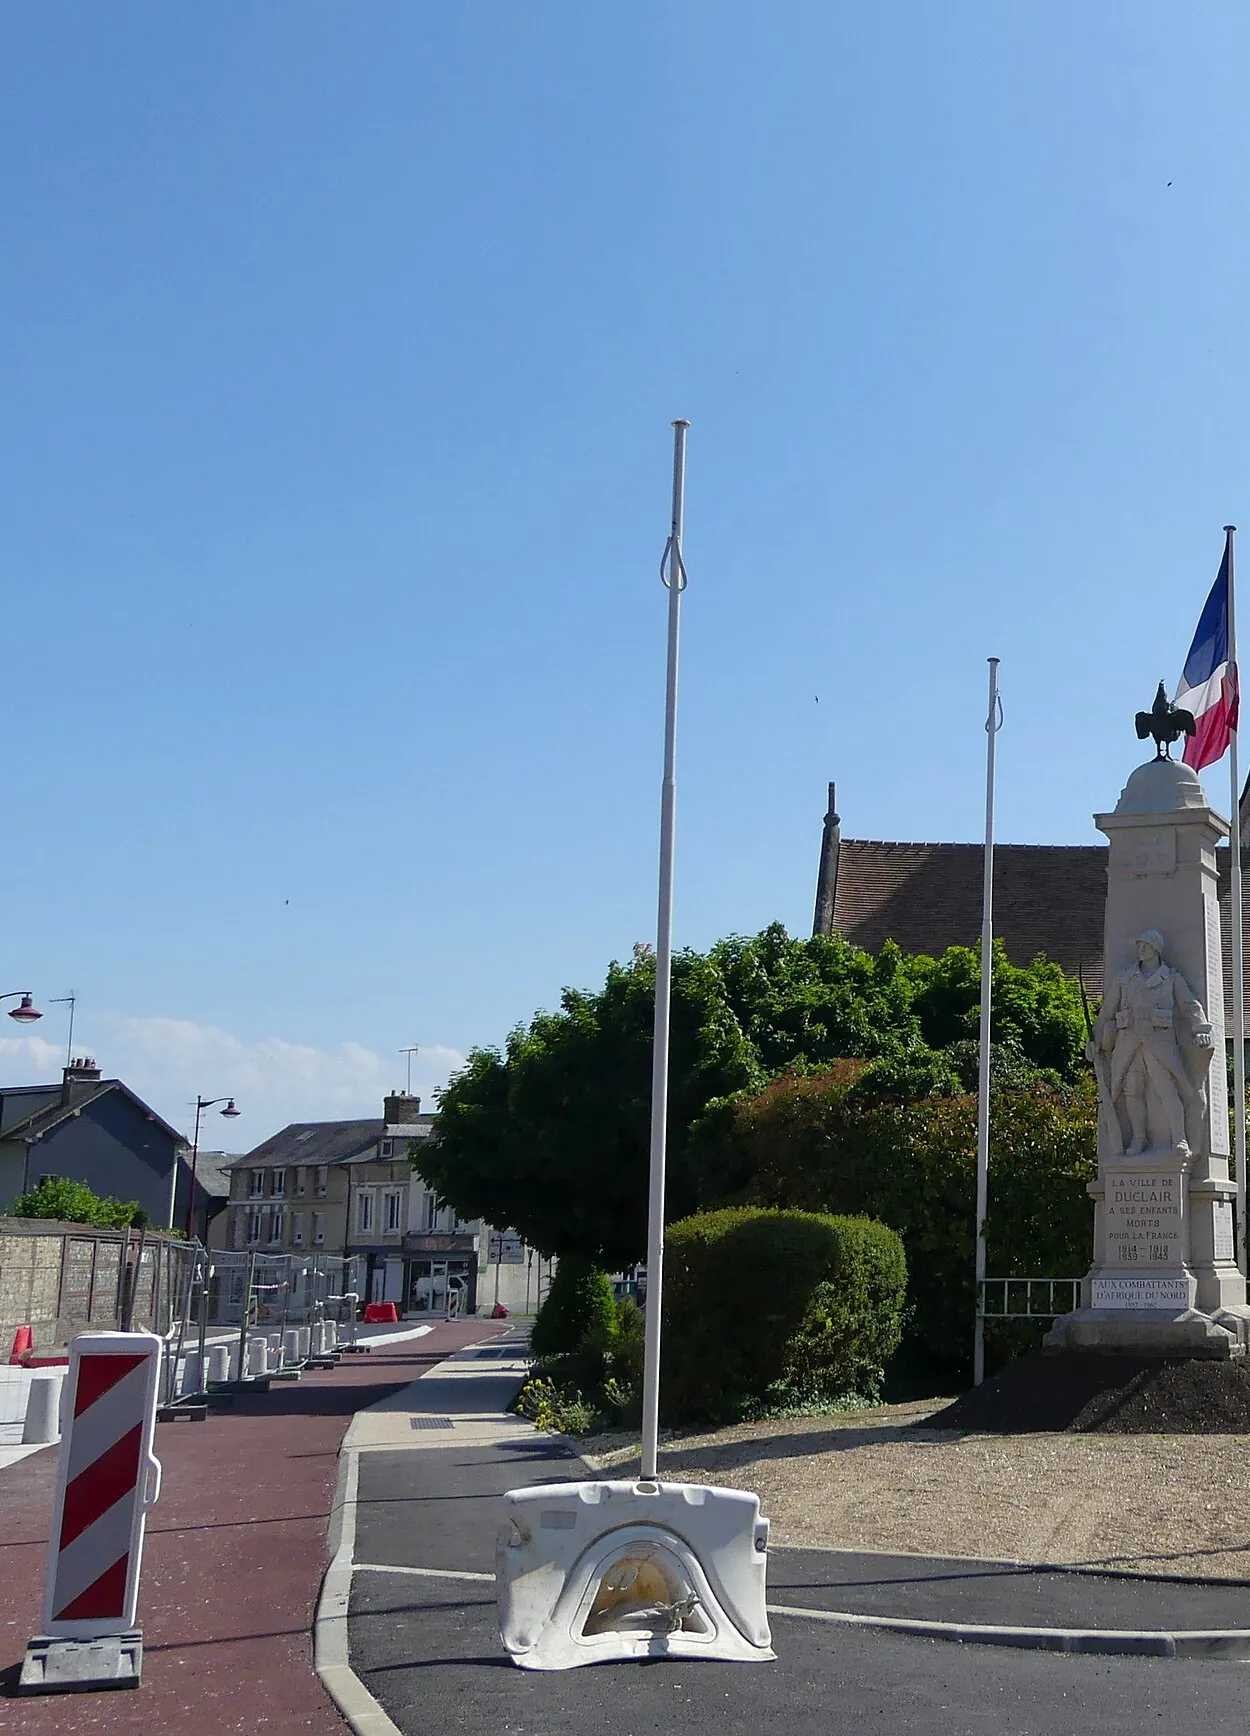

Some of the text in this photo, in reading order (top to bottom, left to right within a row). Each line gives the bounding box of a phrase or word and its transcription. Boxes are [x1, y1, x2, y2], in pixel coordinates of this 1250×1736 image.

[1112, 1179, 1173, 1187] LA VILLE DE
[1115, 1191, 1172, 1202] DUCLAIR
[1109, 1206, 1178, 1215] A SES ENFANTS
[1126, 1219, 1160, 1228] MORTS
[1109, 1231, 1179, 1240] POUR LA FRANCE
[1118, 1244, 1137, 1253] 1914
[1149, 1244, 1169, 1253] 1918
[1118, 1252, 1138, 1261] 1939
[1097, 1281, 1185, 1289] AUX COMBATTANTS
[1096, 1291, 1186, 1300] D'AFRIQUE DU NORD
